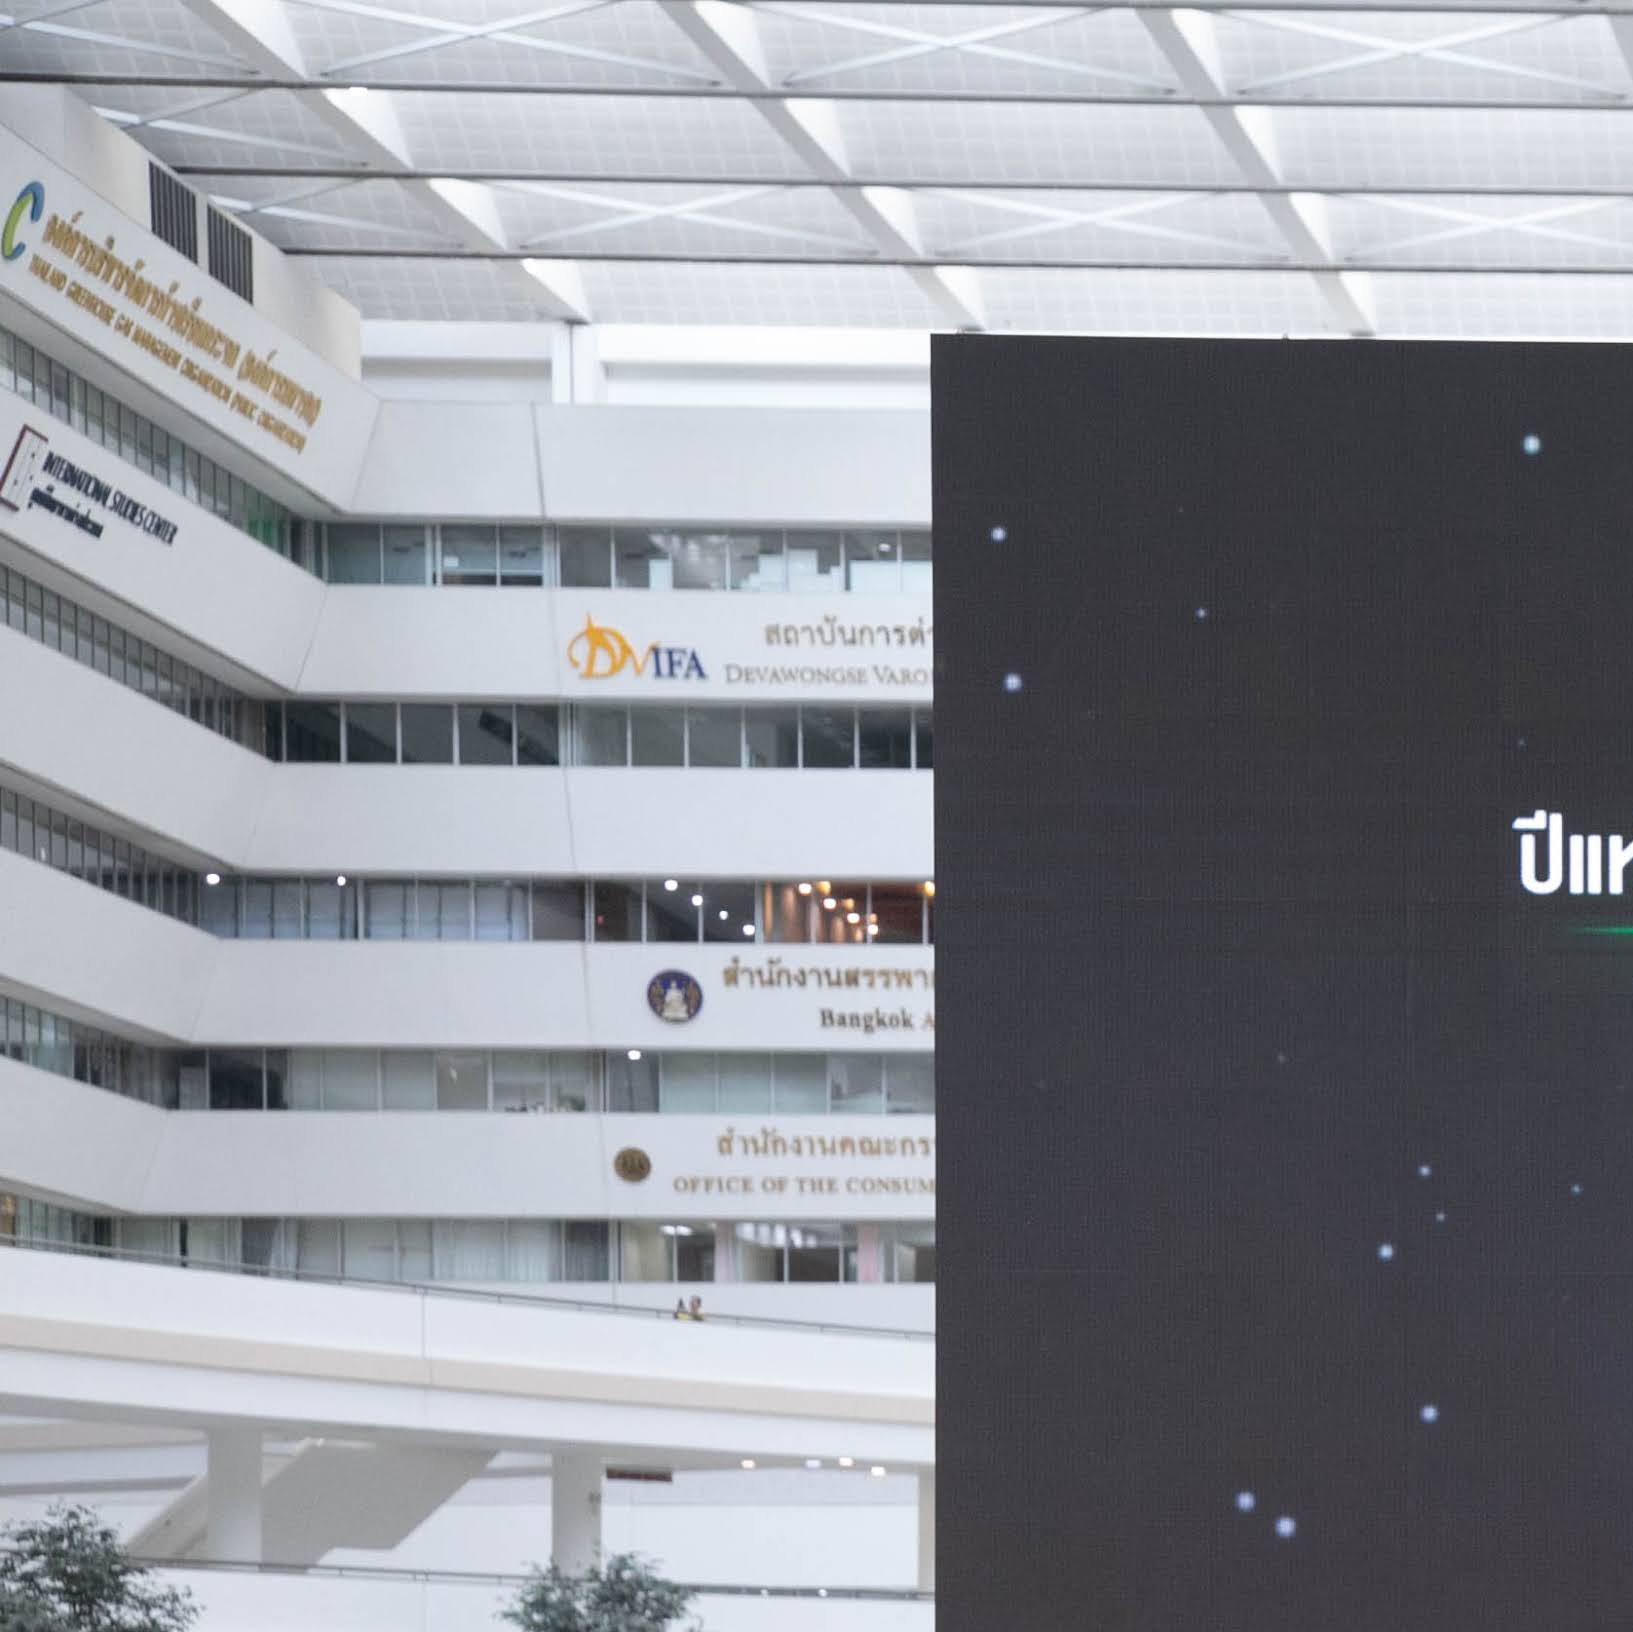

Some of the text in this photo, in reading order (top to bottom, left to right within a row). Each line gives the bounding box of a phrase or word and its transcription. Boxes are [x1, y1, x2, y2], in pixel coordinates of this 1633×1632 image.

[764, 614, 933, 648] สถาบันการต่
[722, 956, 935, 989] สำนักงานสรรพา
[820, 1008, 914, 1033] Bangkok
[673, 1176, 753, 1194] OFFICE
[761, 1176, 789, 1194] OF
[797, 1176, 838, 1194] THE
